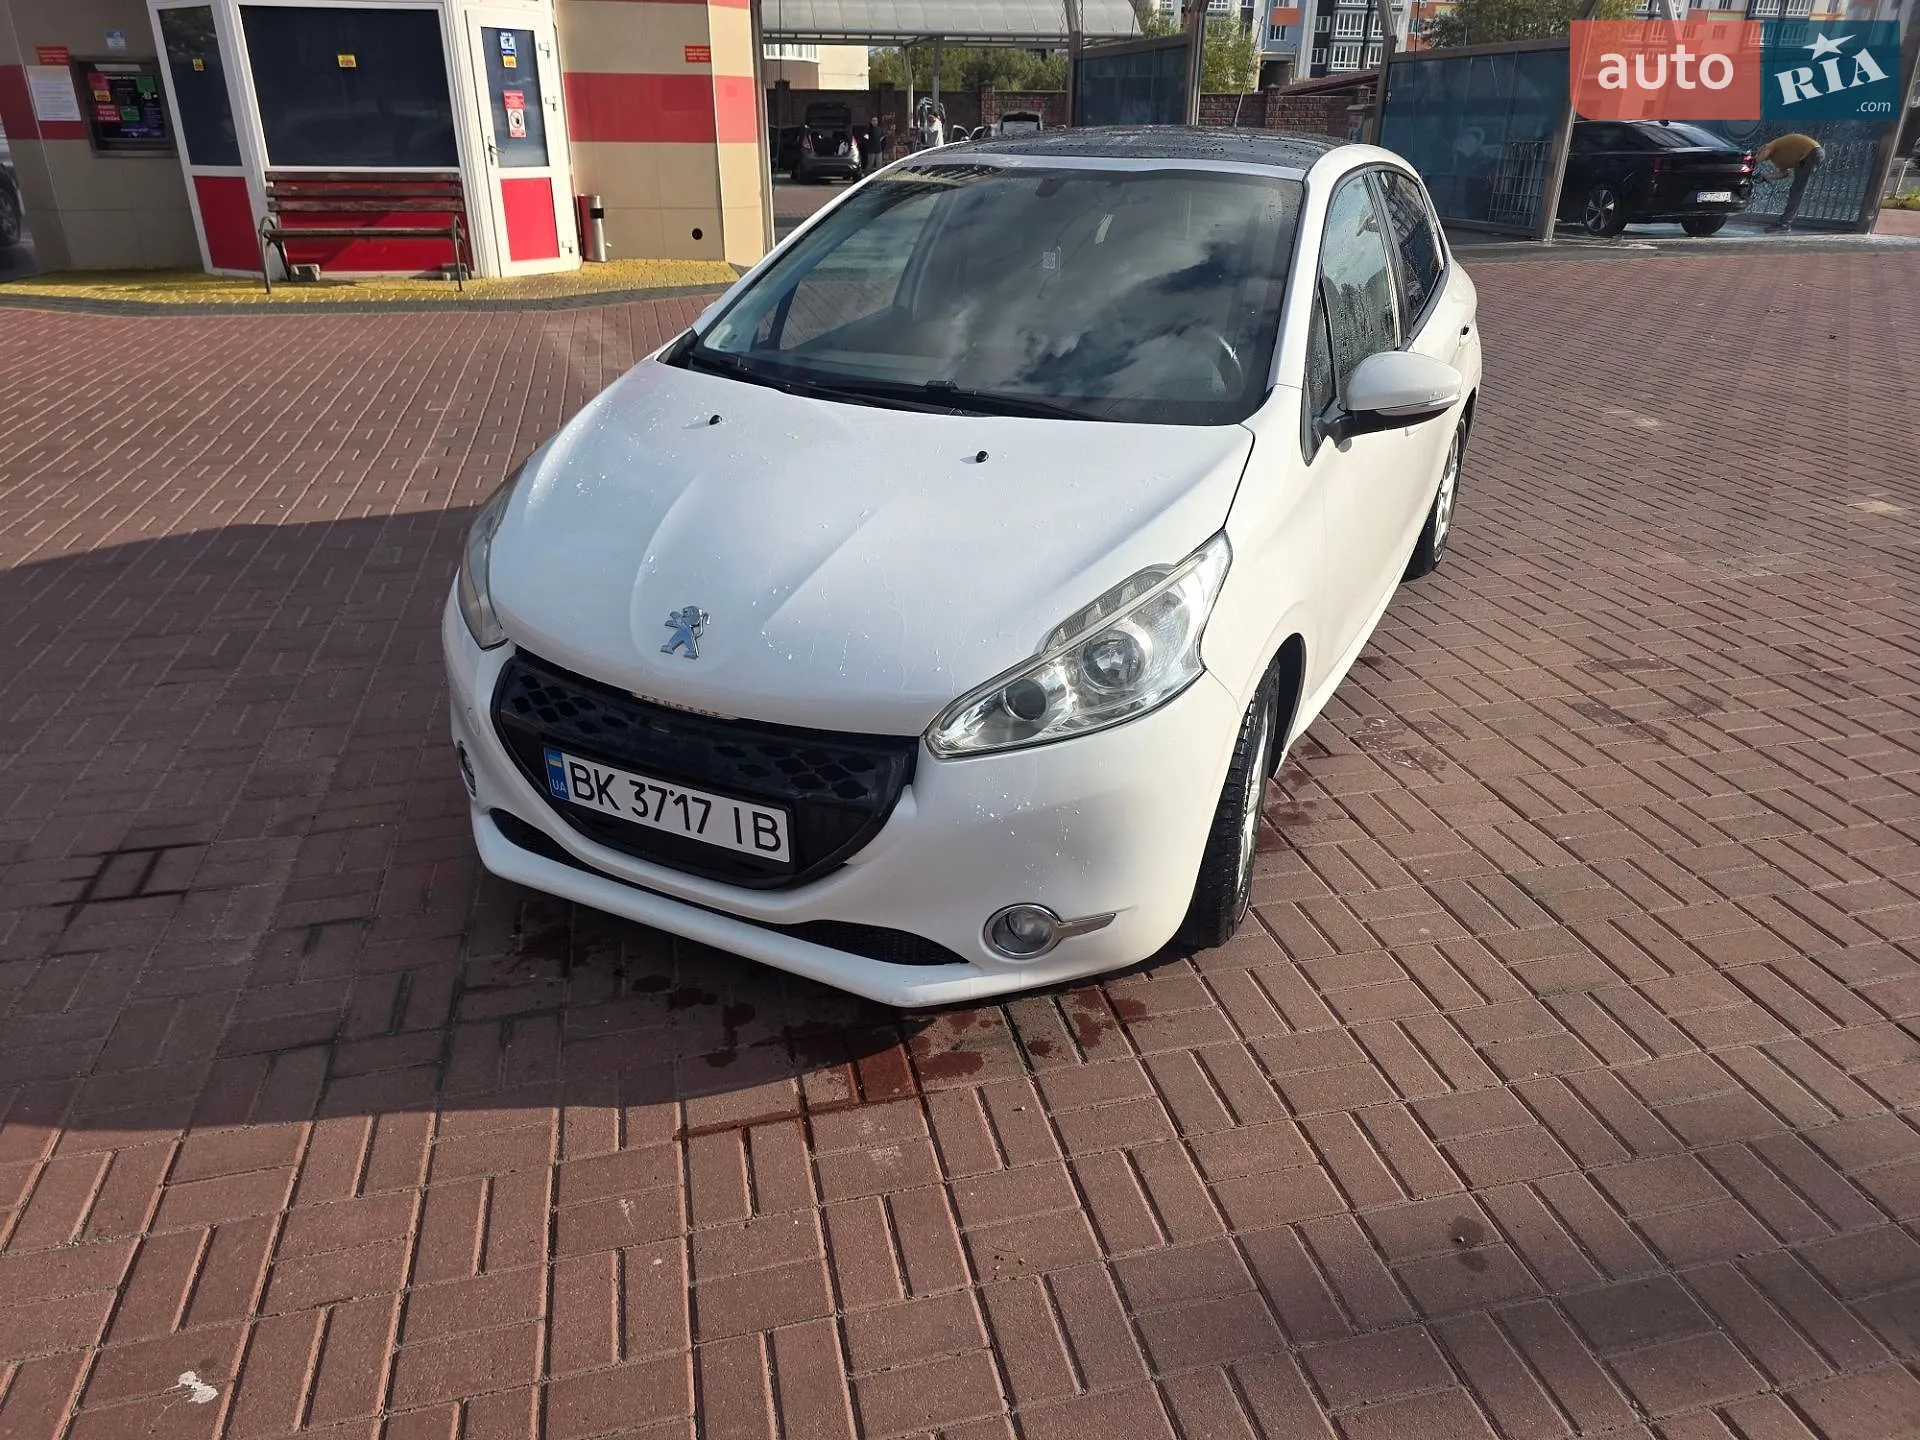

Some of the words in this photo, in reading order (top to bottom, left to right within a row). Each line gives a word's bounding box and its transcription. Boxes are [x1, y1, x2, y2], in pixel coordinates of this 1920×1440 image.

[551, 778, 568, 793] UA
[568, 761, 621, 811] BK
[628, 779, 712, 834] 3717
[733, 806, 781, 852] IB
